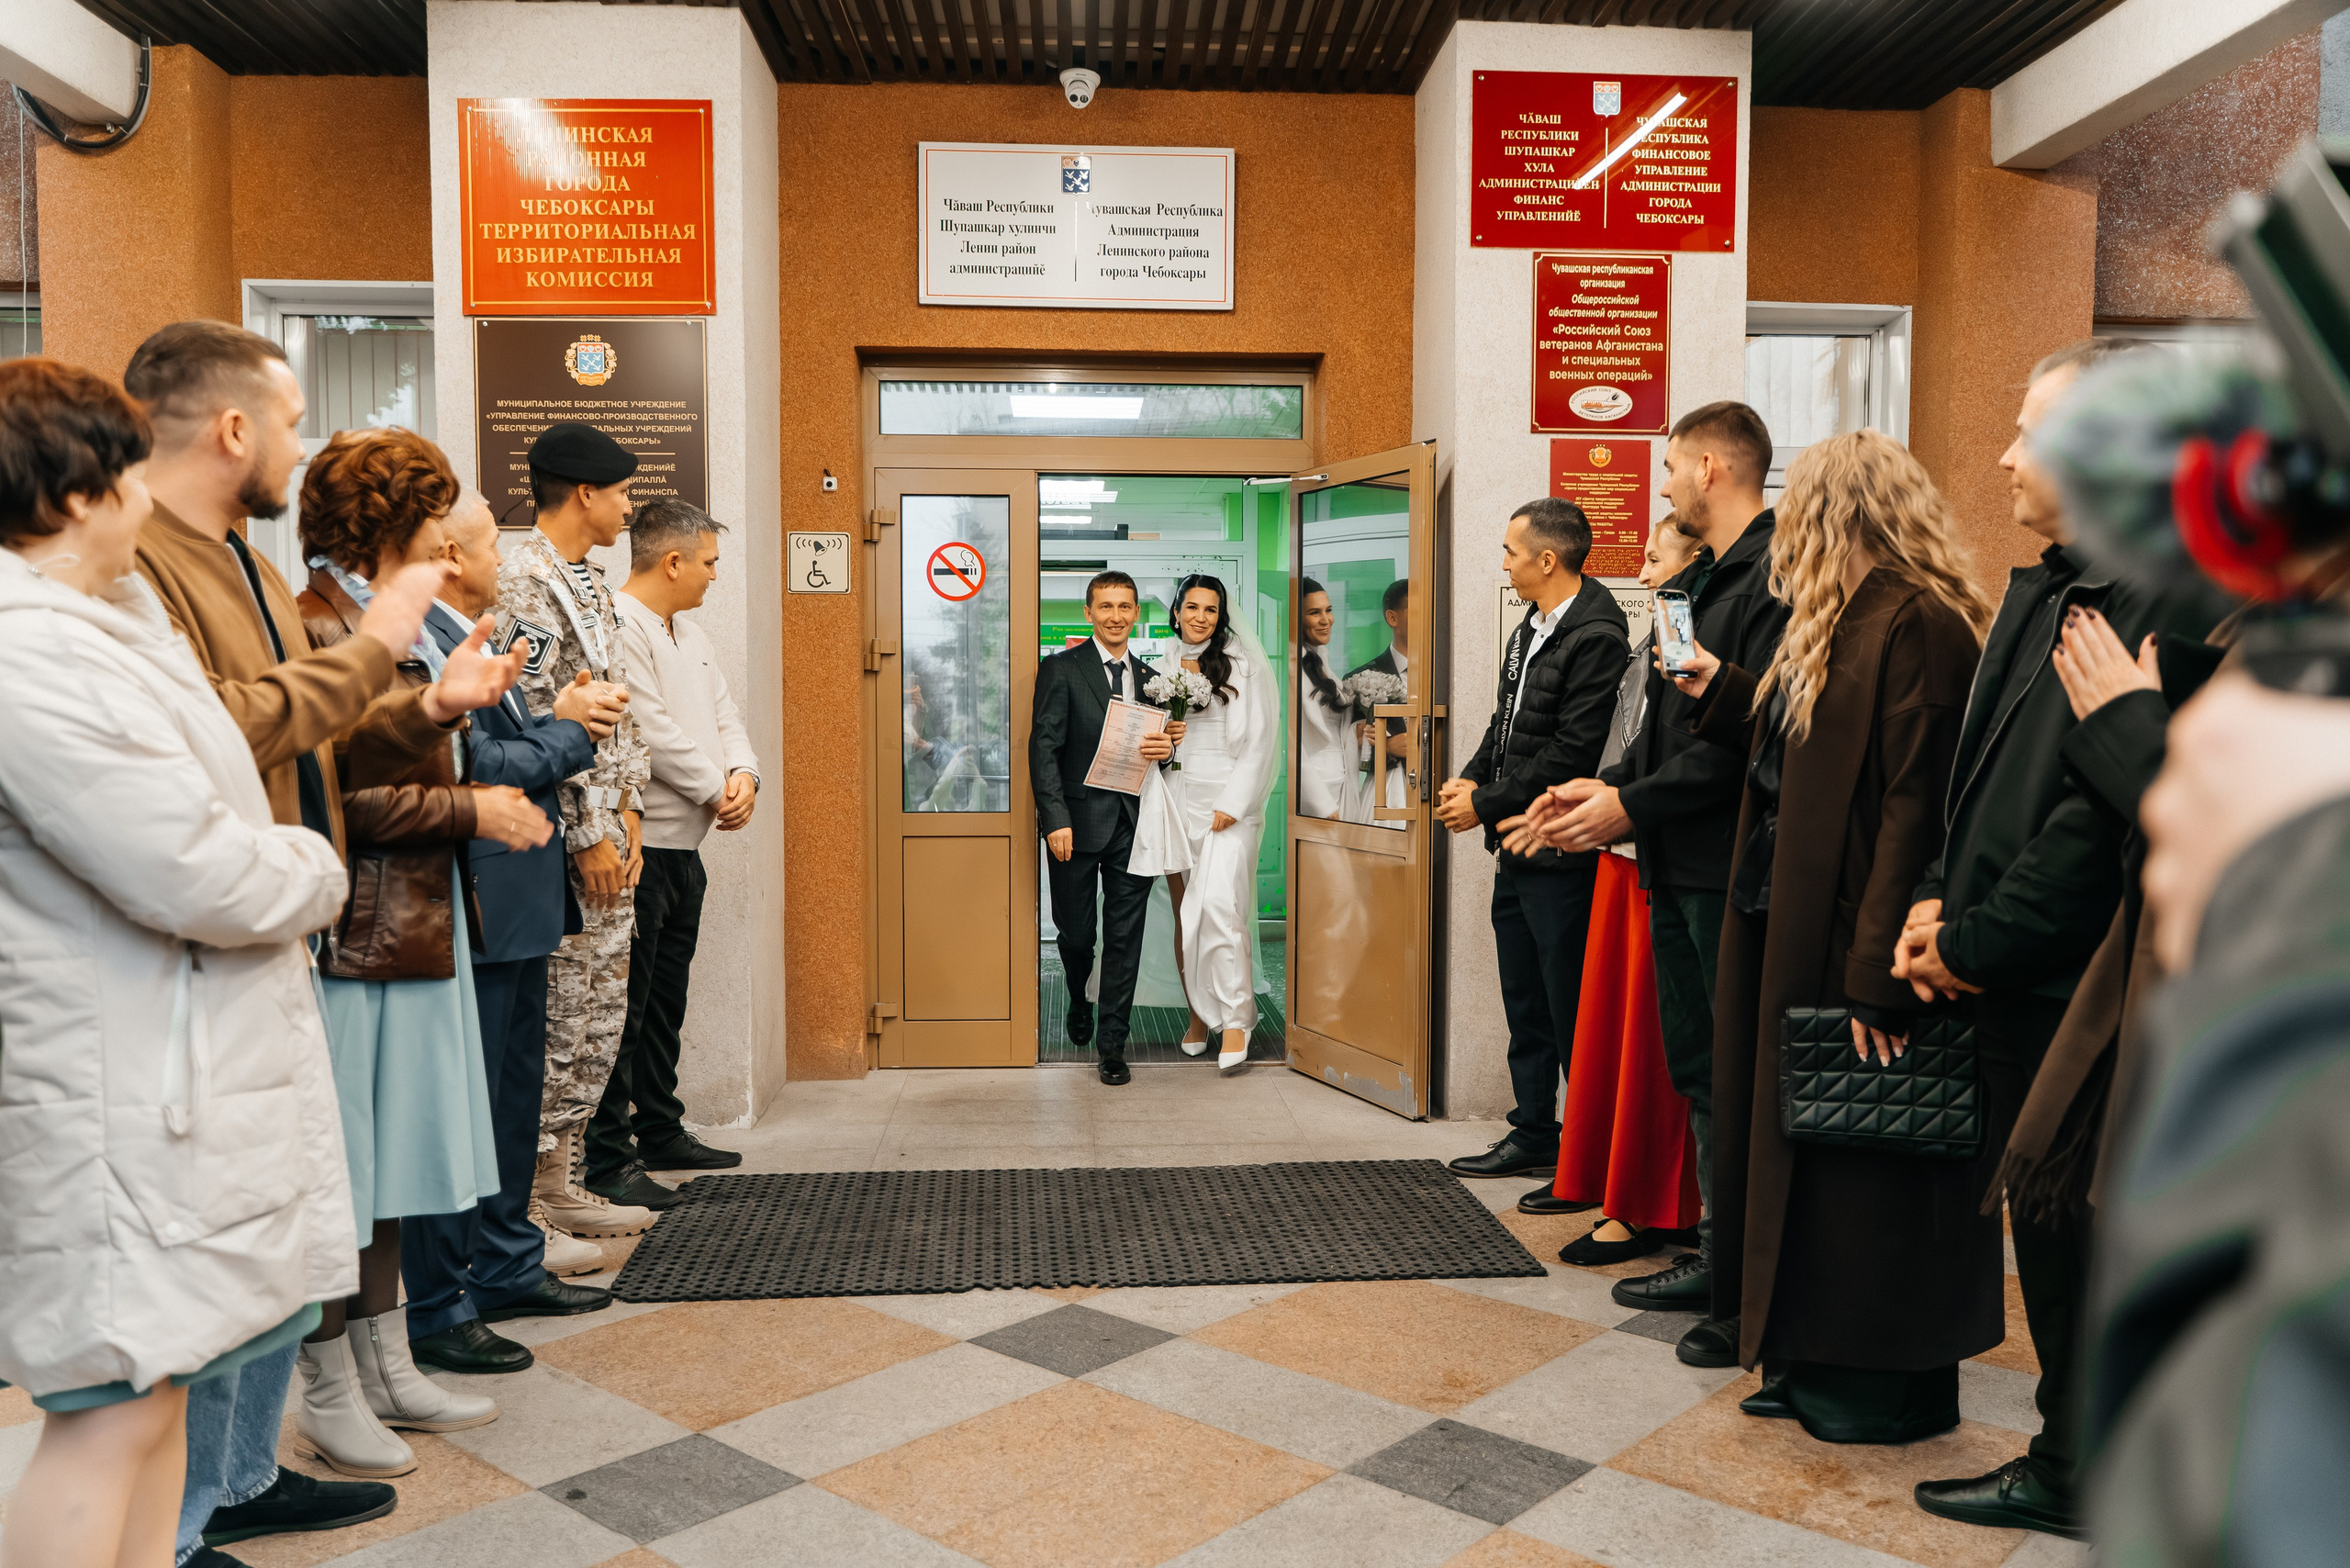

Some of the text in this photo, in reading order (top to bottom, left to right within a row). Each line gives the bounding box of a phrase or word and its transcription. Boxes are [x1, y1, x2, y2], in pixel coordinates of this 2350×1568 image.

[1636, 117, 1708, 129] ЧУАШСКАЯ
[521, 127, 654, 144] ИНСКАЯ
[1501, 129, 1579, 141] РЕСПУБЛИКИ
[1639, 133, 1709, 145] ЕСПУБЛИКА
[1505, 146, 1575, 157] ШУПАШКАР
[1631, 149, 1711, 161] ФИНАНСОВОЕ
[526, 151, 647, 168] РОННАЯ
[1524, 162, 1555, 174] ХУЛА
[1634, 165, 1708, 176] УПРАВЛЕНИЕ
[544, 175, 632, 195] ГОРОДА
[1479, 178, 1600, 191] АДМИНИСТРАЦИН
[1620, 181, 1721, 194] АДМИНИСТРАЦИИ
[1514, 195, 1565, 206] ФИНАНС
[1649, 197, 1693, 209] ГОРОДА
[520, 199, 655, 216] ЧЕБОКСАРЫ
[986, 199, 1055, 216] Республики
[1156, 203, 1224, 219] Республика
[1636, 213, 1705, 225] ЧЕБОКСАРЫ
[479, 223, 697, 241] ТЕРРИТОРИАЛЬНАЯ
[939, 219, 1057, 237] Шупашкар хулинчи
[1107, 223, 1200, 241] Администрация
[496, 247, 682, 264] ИЗБИРАТЕЛЬНАЯ
[960, 241, 1036, 257] Ленин район
[1096, 243, 1210, 261] Ленинского района
[1100, 265, 1207, 282] города Чебоксары
[1551, 263, 1654, 275] Чувашская республиканская
[525, 271, 655, 288] КОМИССИЯ
[1580, 279, 1626, 289] организация
[1572, 293, 1639, 306] Общероссийской
[1549, 307, 1658, 320] общественной организации
[1552, 323, 1651, 336] «Российский Союз
[1539, 339, 1664, 353] ветеранов Афганистана
[1561, 355, 1641, 366] и специальных
[1550, 369, 1652, 383] военных операций»
[497, 399, 687, 409] МУНИЦИПАЛЬНОЕ БЮДЖЕТНОЕ УЧРЕЖДЕНИЕ
[486, 412, 699, 421] «УПРАВЛЕНИЕ ФИНАНСОВО-ПРОИЗВОДСТВЕННОГО
[492, 424, 554, 432] ОБЕСПЕЧЕНИ
[635, 424, 692, 434] УЧРЕЖДЕНИЙ
[611, 437, 662, 445] БОКСАРЫ»
[631, 488, 679, 497] ФИНАНСПА
[1507, 648, 1520, 681] CALVIN
[1504, 693, 1514, 719] KLEIN
